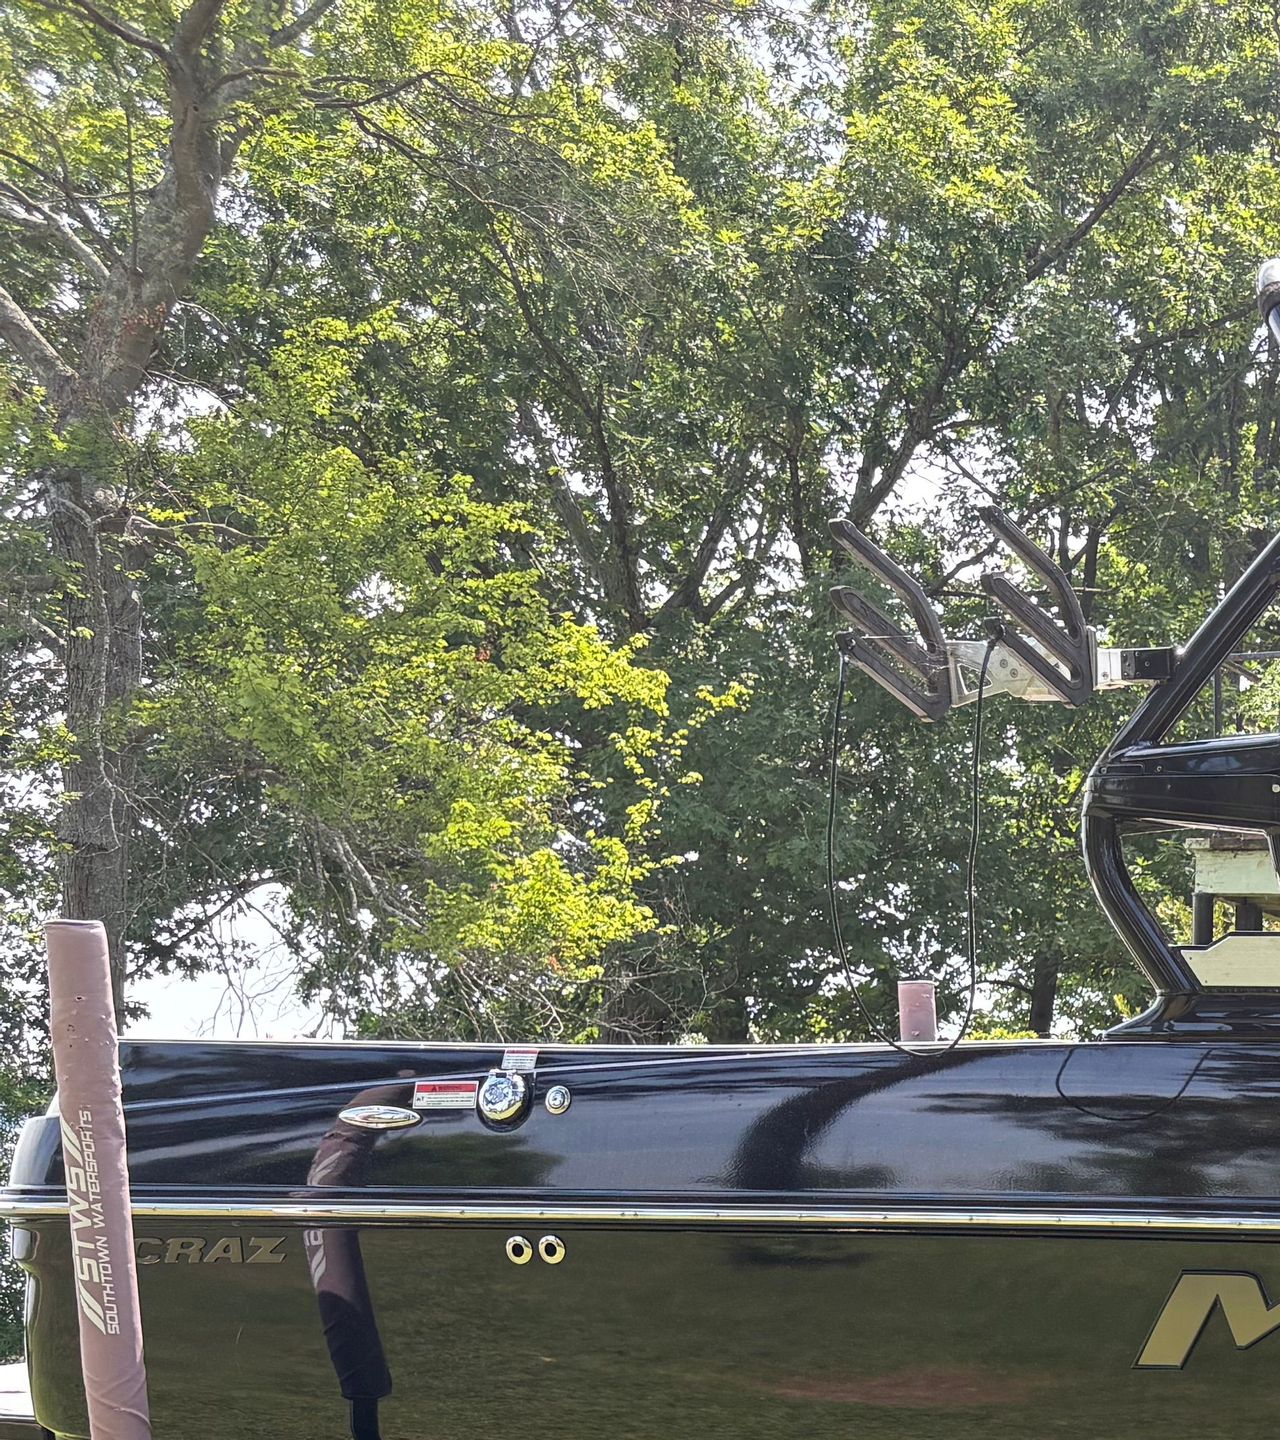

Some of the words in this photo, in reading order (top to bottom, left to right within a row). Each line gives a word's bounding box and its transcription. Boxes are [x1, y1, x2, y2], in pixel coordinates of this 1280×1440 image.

[65, 1165, 100, 1283] STWS
[78, 1109, 106, 1229] WATERSPORTS
[97, 1235, 121, 1336] SOUTHTOWN
